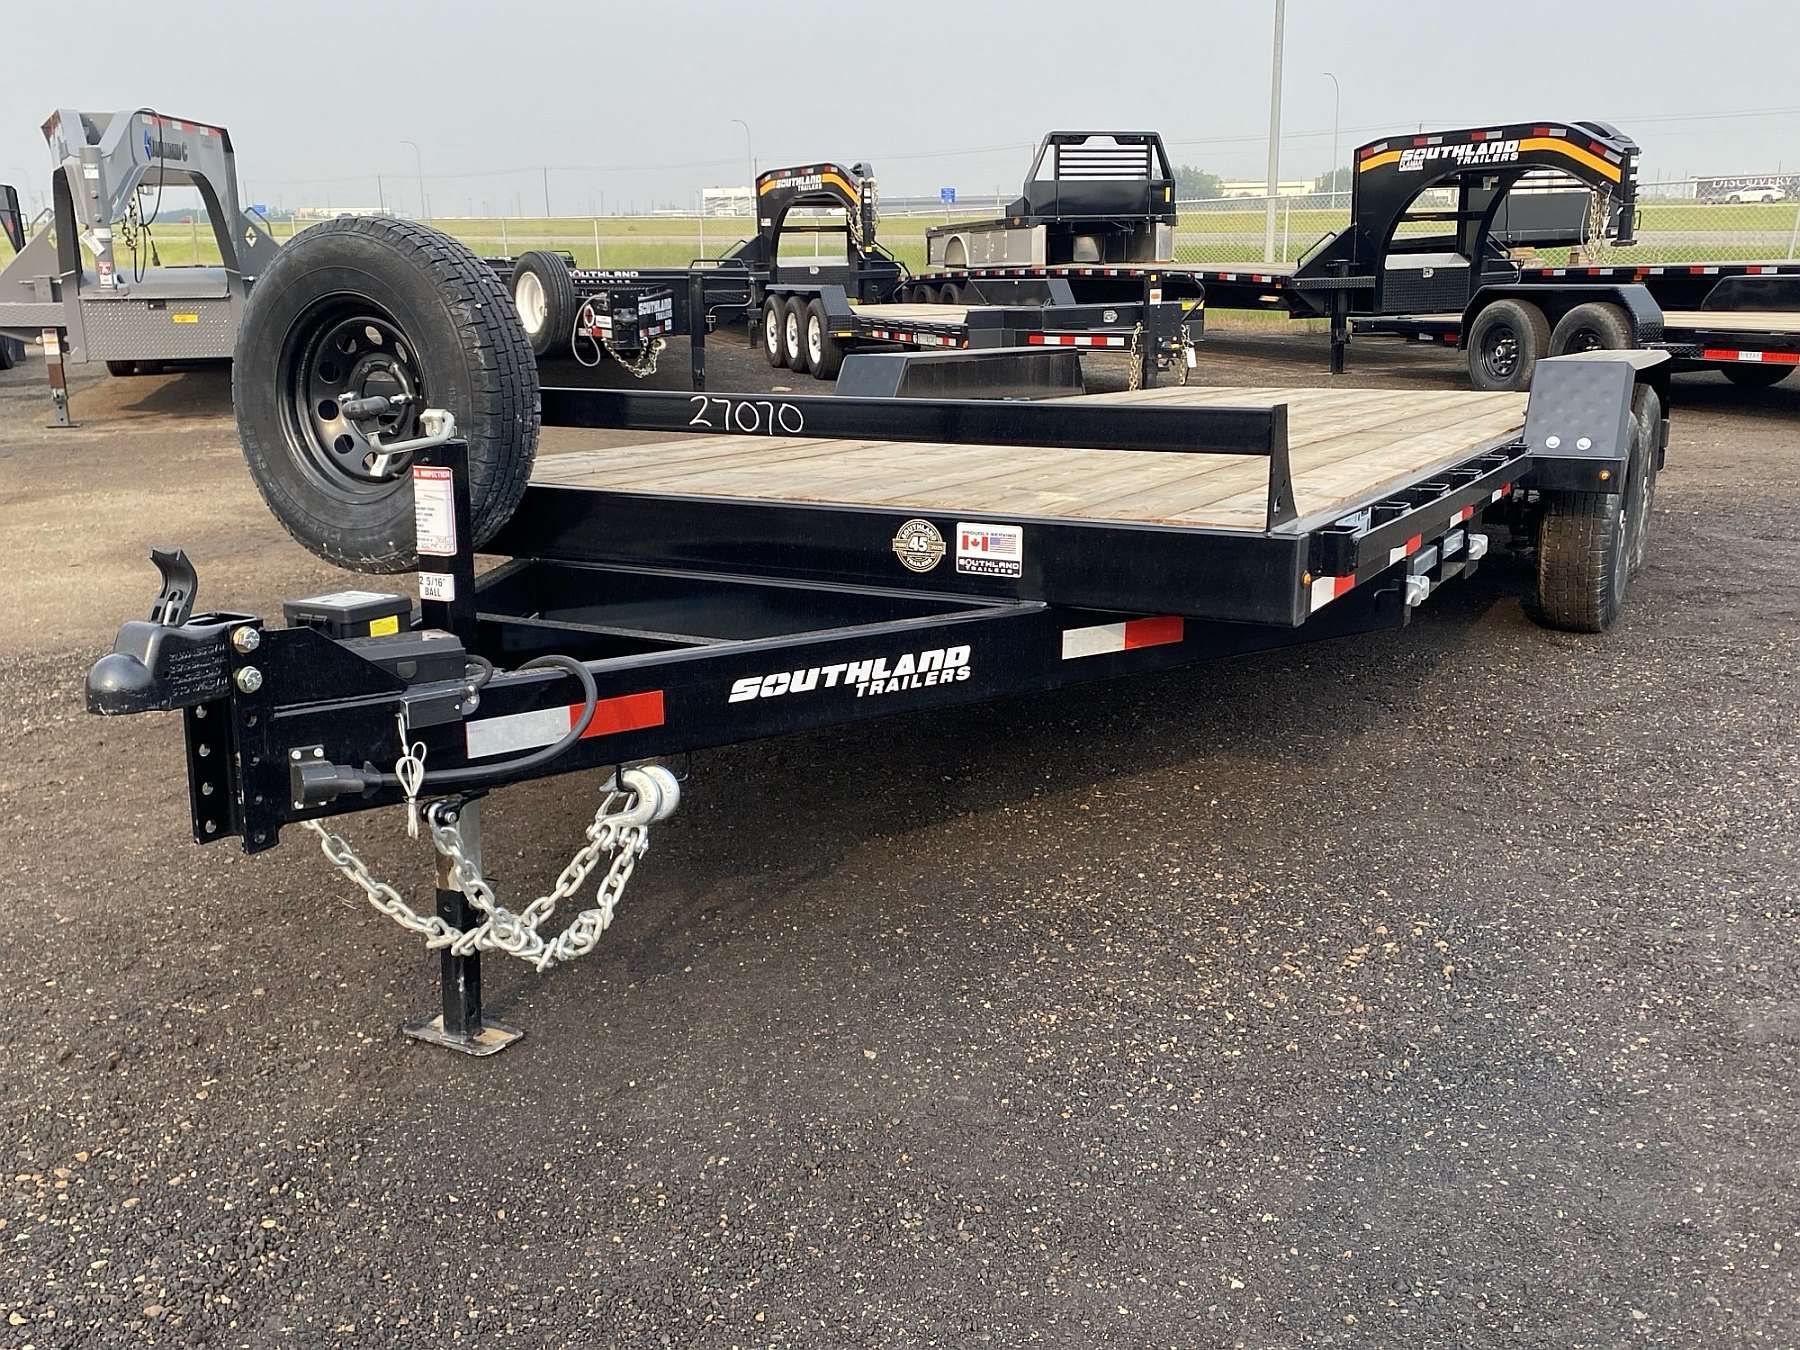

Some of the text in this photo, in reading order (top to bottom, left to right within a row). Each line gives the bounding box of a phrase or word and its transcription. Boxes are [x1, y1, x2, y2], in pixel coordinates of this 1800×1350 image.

[1400, 140, 1519, 161] SOUTHLAND
[1456, 152, 1519, 166] TRAILERS
[776, 175, 822, 188] SOUTHLAND
[1712, 177, 1791, 187] DISCOVERY
[689, 395, 804, 436] 27070
[902, 523, 937, 541] SOUTHLAND
[908, 536, 929, 552] 45
[959, 558, 1020, 571] SOUTHLAND
[965, 566, 1013, 575] TRAILERS
[419, 576, 424, 585] 2
[424, 587, 442, 597] BALL
[728, 645, 971, 703] SOUTHLAND
[855, 666, 971, 698] TRAILERS
